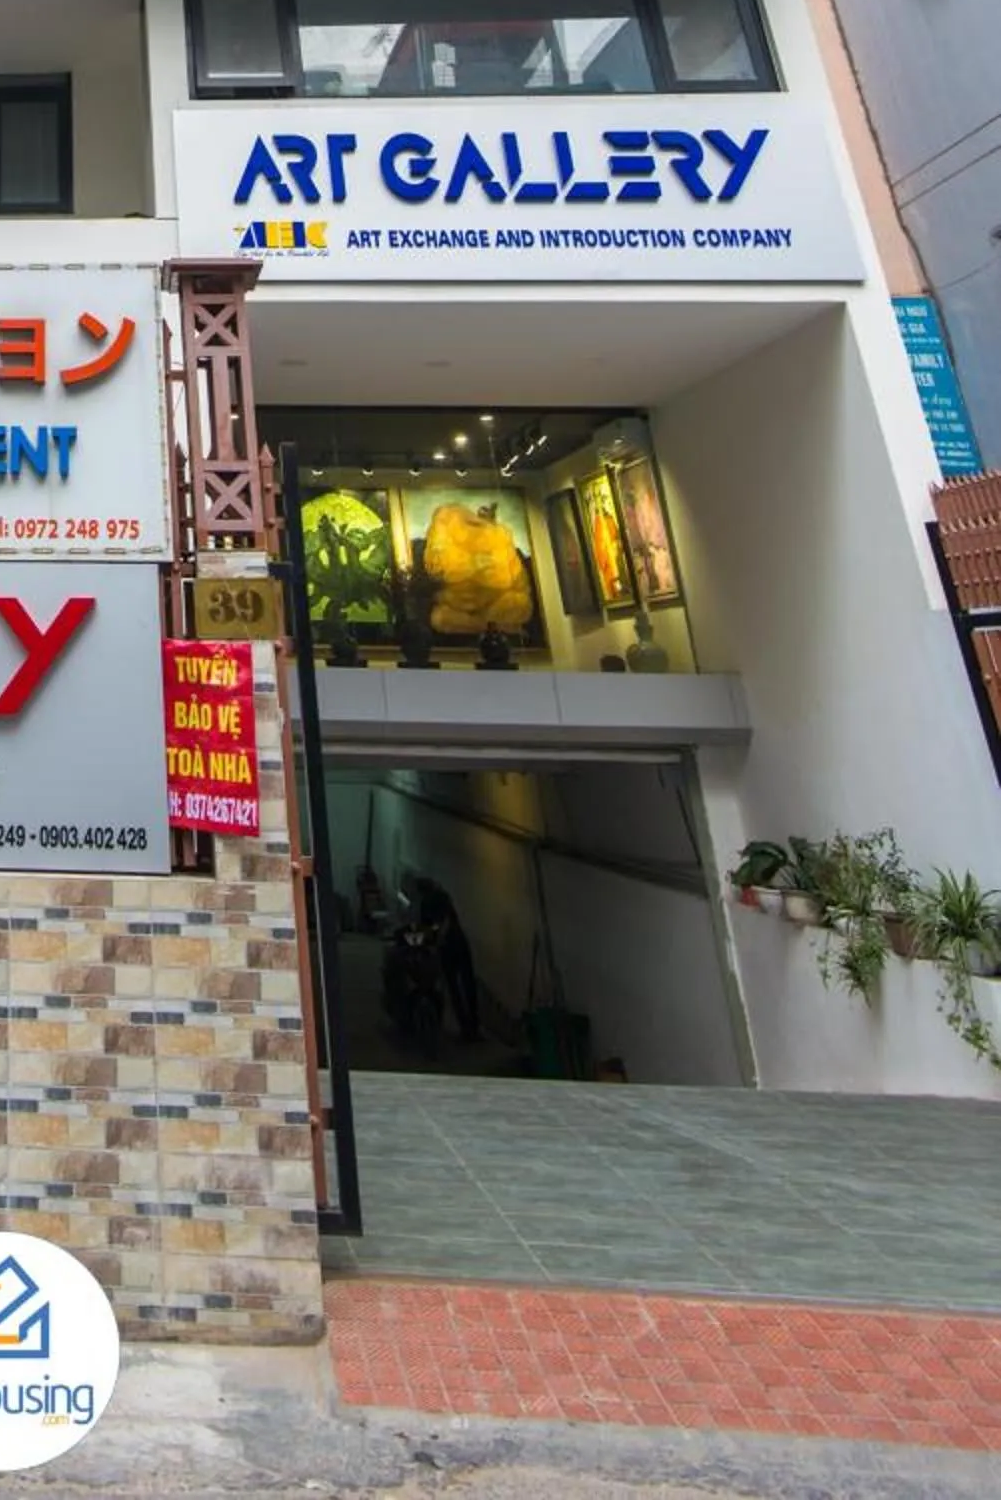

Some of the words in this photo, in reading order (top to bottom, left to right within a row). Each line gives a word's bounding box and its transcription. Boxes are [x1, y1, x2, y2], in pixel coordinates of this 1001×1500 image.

[233, 133, 357, 204] ART
[380, 129, 769, 204] GALLERY
[346, 229, 382, 249] ART
[388, 229, 491, 249] EXCHANGE
[495, 229, 535, 249] AND
[539, 229, 686, 249] INTRODUCTION
[692, 228, 792, 248] COMPANY
[14, 519, 58, 540] 0972
[65, 520, 99, 540] 248
[106, 520, 140, 540] 975
[209, 587, 265, 625] 39
[174, 694, 212, 731] BẢO
[218, 700, 242, 741] VỆ
[167, 744, 205, 780] TOÀ
[209, 750, 253, 785] NHÀ
